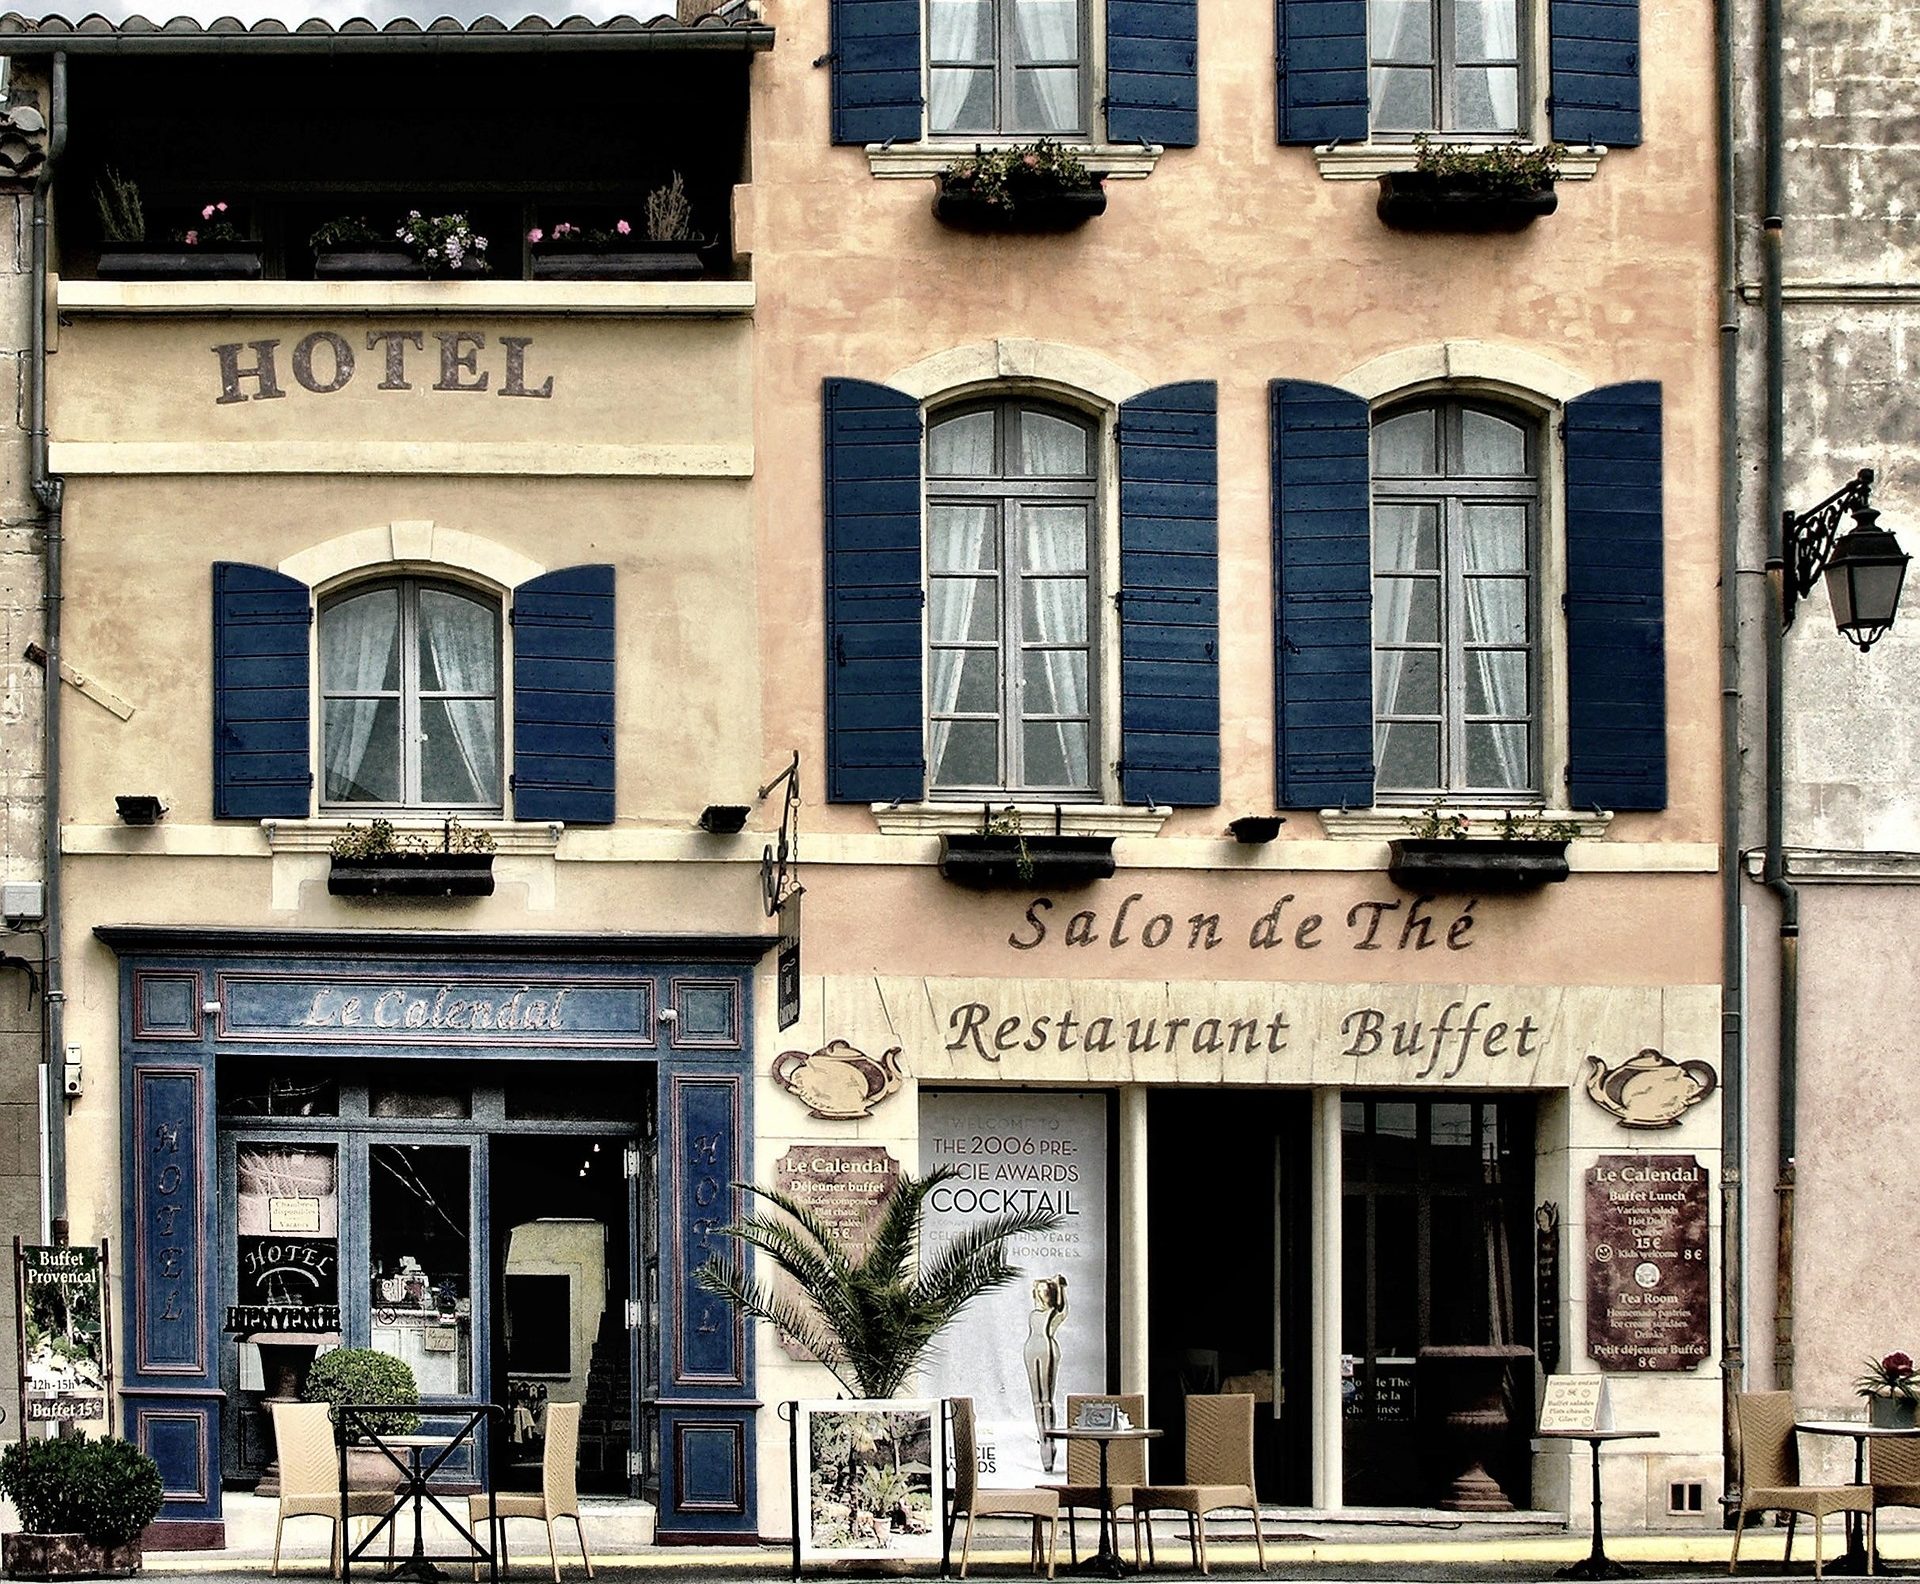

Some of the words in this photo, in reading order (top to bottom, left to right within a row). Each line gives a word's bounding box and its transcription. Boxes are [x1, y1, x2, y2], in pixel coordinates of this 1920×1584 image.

[211, 330, 555, 405] HOTEL
[1008, 893, 1223, 950] Salon
[1249, 894, 1323, 950] de
[1346, 895, 1479, 951] Thé
[301, 987, 361, 1028] Le
[374, 985, 573, 1031] Calendal
[945, 1001, 1291, 1063] Restaurant
[1340, 1001, 1539, 1079] Buffet
[932, 1138, 967, 1154] THE
[971, 1136, 1035, 1155] 2006
[1040, 1140, 1078, 1156] PRE-
[786, 1159, 809, 1173] Le
[811, 1158, 889, 1173] Calendal
[995, 1163, 1079, 1182] AWARDS
[1595, 1167, 1617, 1182] Le
[1621, 1166, 1698, 1182] Calendal
[791, 1180, 845, 1193] Déjeuner
[848, 1181, 885, 1192] buffet
[931, 1188, 1079, 1214] COCKTAIL
[1609, 1191, 1647, 1201] Buffet
[1649, 1191, 1686, 1201] Lunch
[1636, 1238, 1651, 1249] 15
[1652, 1238, 1661, 1249] €
[39, 1251, 84, 1266] Buffet
[245, 1241, 334, 1276] HOTEL
[1684, 1249, 1692, 1260] 8
[1693, 1249, 1702, 1260] €
[28, 1268, 97, 1285] Provençal
[1618, 1293, 1640, 1303] Tea
[1643, 1293, 1679, 1303] Room
[226, 1306, 341, 1331] BIENVENUE
[1594, 1344, 1620, 1355] Petit
[1620, 1344, 1669, 1356] déjeuner
[1670, 1344, 1704, 1355] Buffet
[1638, 1357, 1646, 1368] 8
[1648, 1357, 1657, 1368] €
[32, 1403, 75, 1417] Buffet
